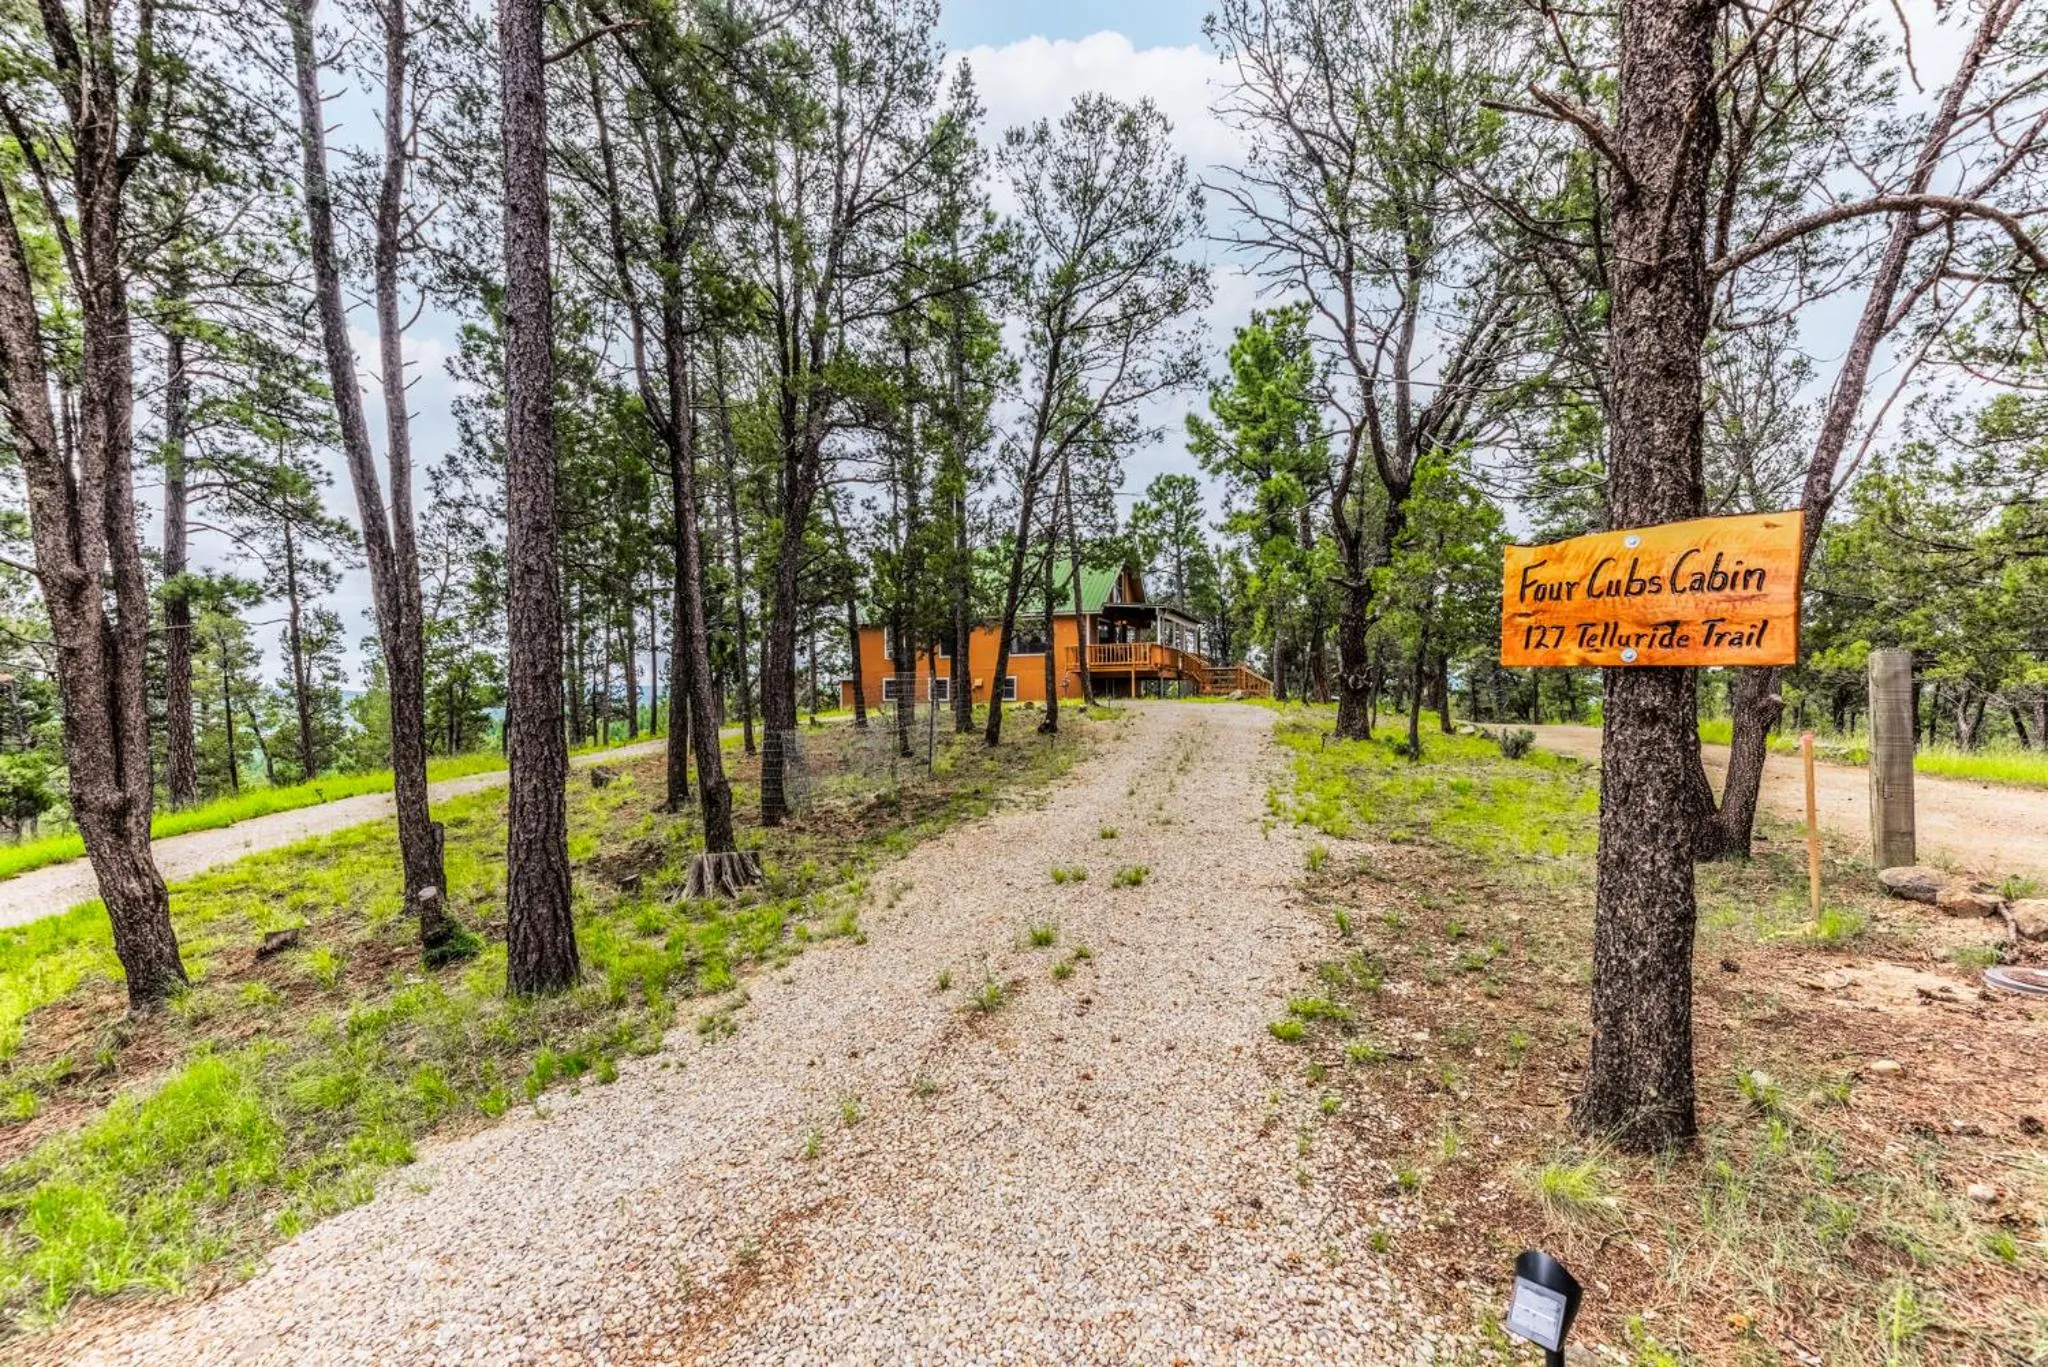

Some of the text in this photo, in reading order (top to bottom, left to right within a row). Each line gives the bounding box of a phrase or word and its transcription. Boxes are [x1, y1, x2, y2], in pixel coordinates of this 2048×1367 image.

[1519, 548, 1766, 603] Four Cubs Cabin
[1524, 617, 1769, 650] 127 Telluride Trail
